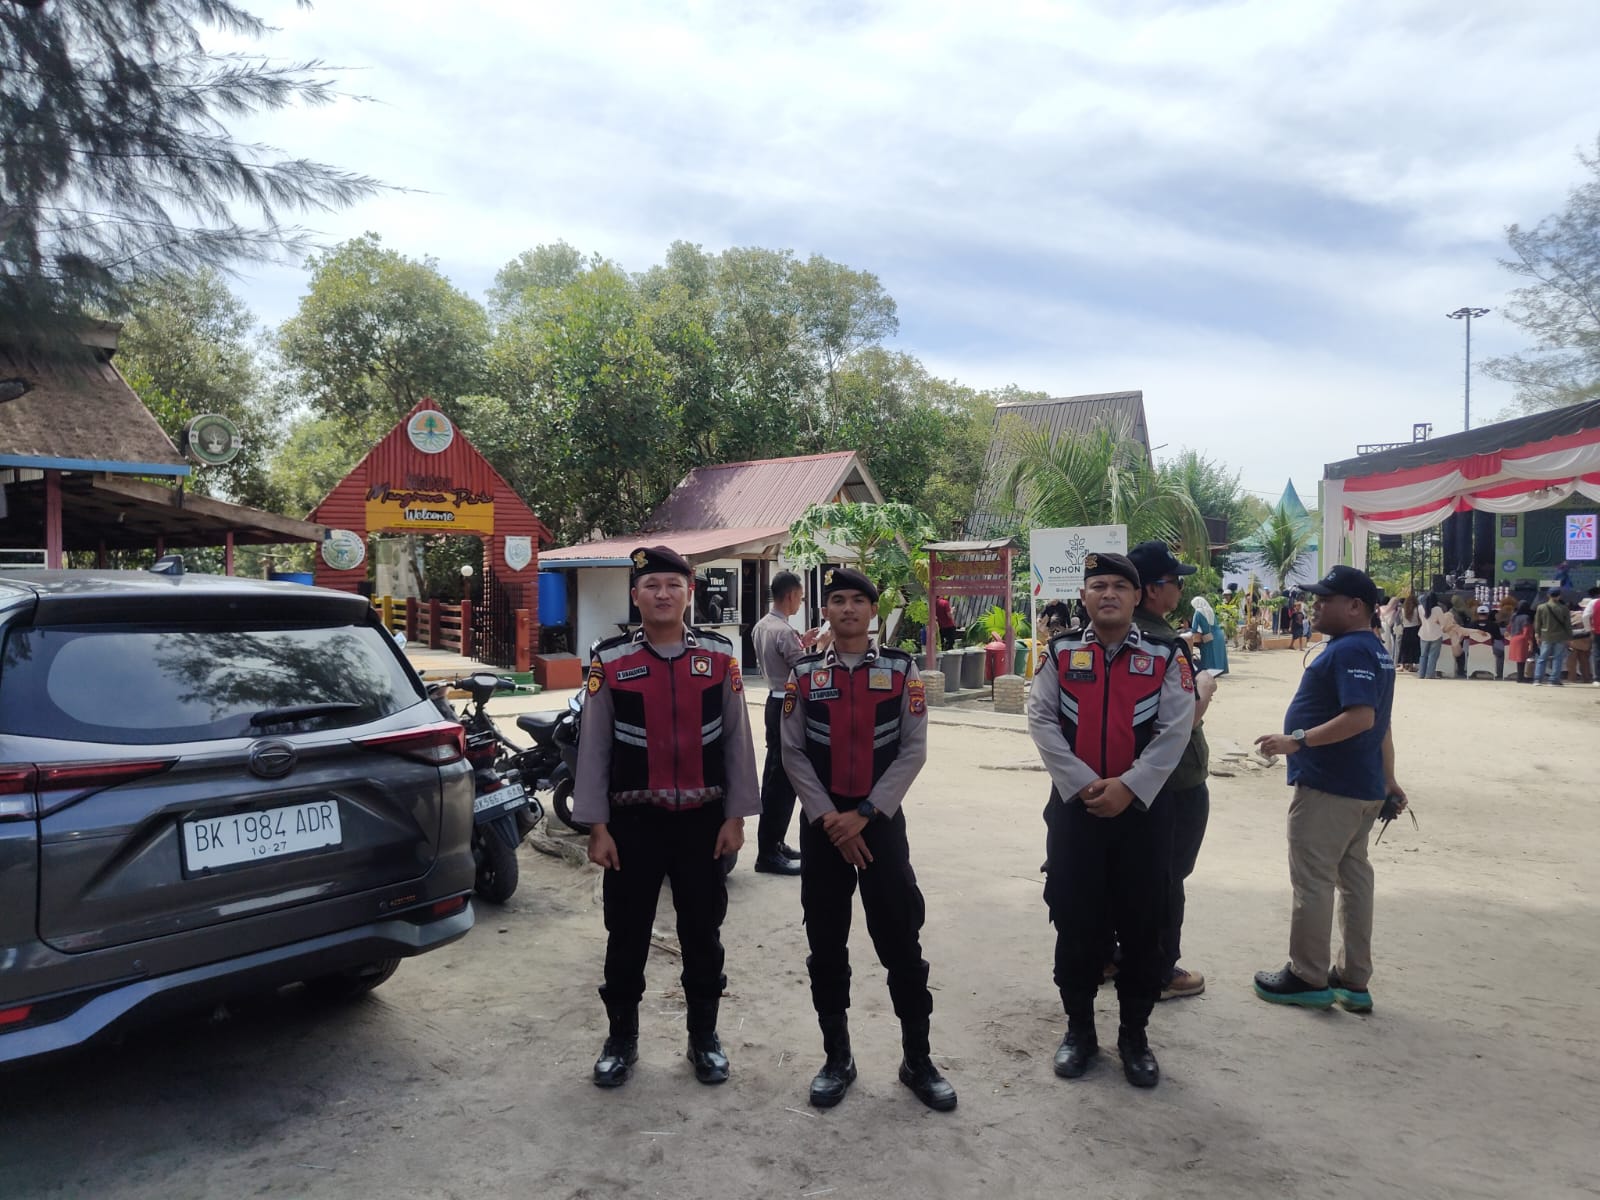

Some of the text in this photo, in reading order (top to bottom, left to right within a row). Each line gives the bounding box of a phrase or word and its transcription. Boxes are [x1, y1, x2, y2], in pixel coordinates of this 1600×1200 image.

[405, 507, 454, 521] Welcome
[1049, 566, 1080, 574] POHON
[195, 804, 334, 852] BK 1984 ADR
